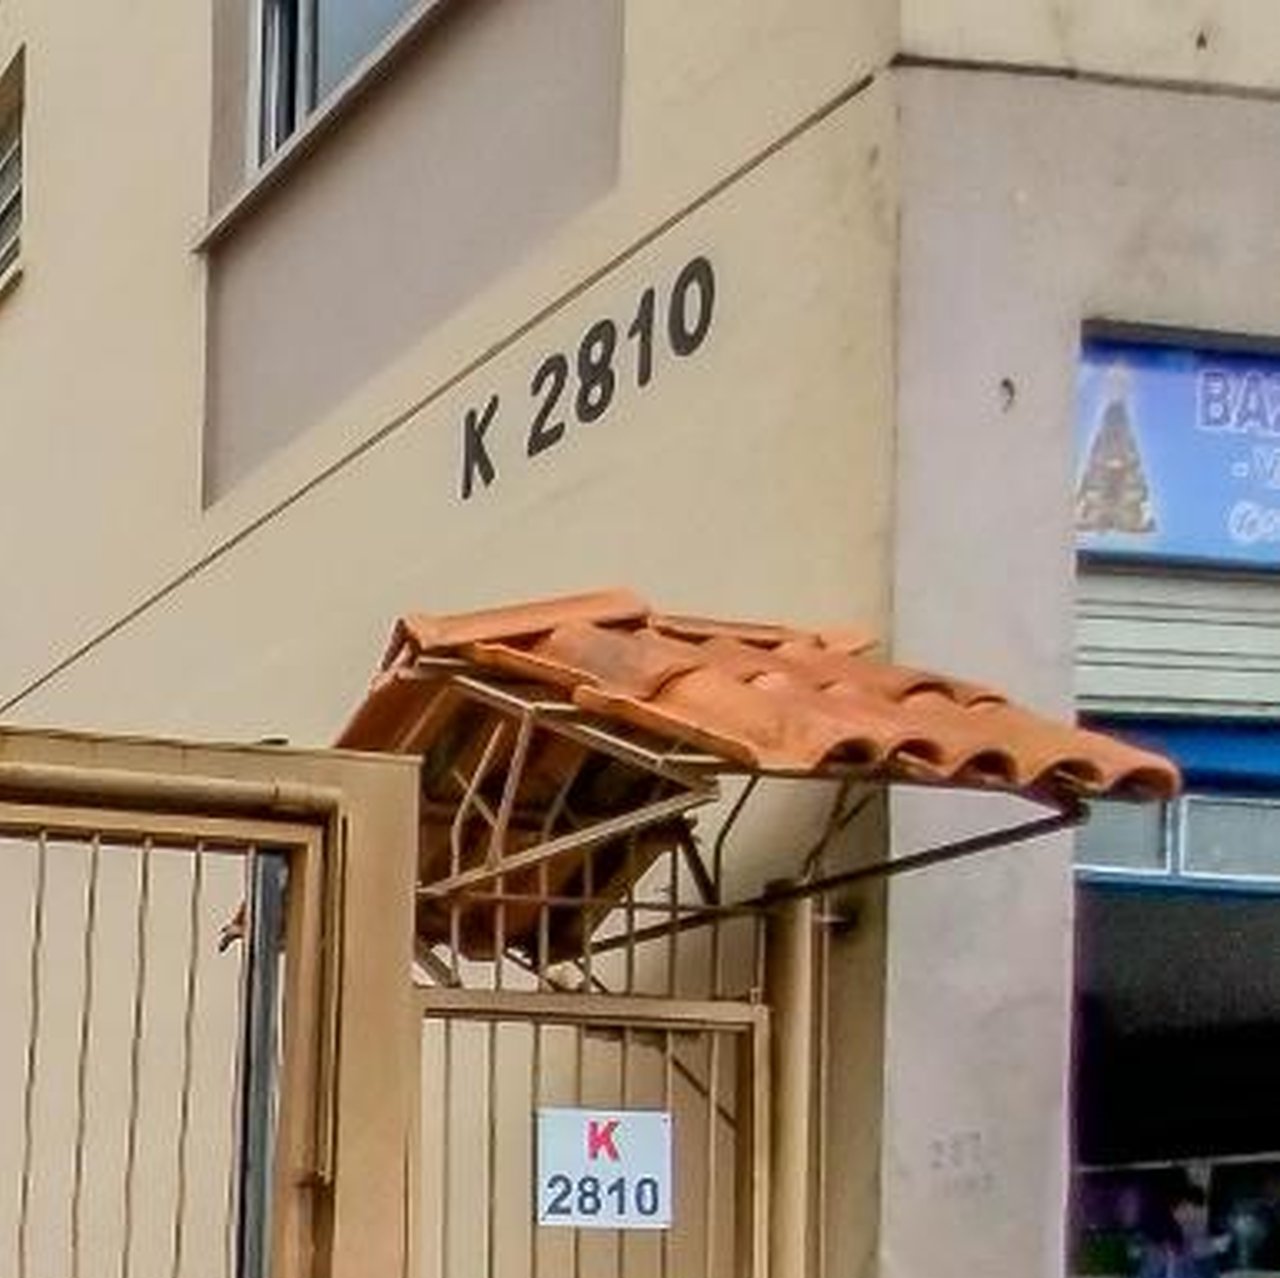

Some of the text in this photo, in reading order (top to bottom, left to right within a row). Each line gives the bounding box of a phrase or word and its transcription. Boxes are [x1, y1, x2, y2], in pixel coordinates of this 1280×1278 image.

[461, 255, 716, 499] K 2810
[587, 1119, 621, 1161] K
[546, 1174, 660, 1217] 2810
